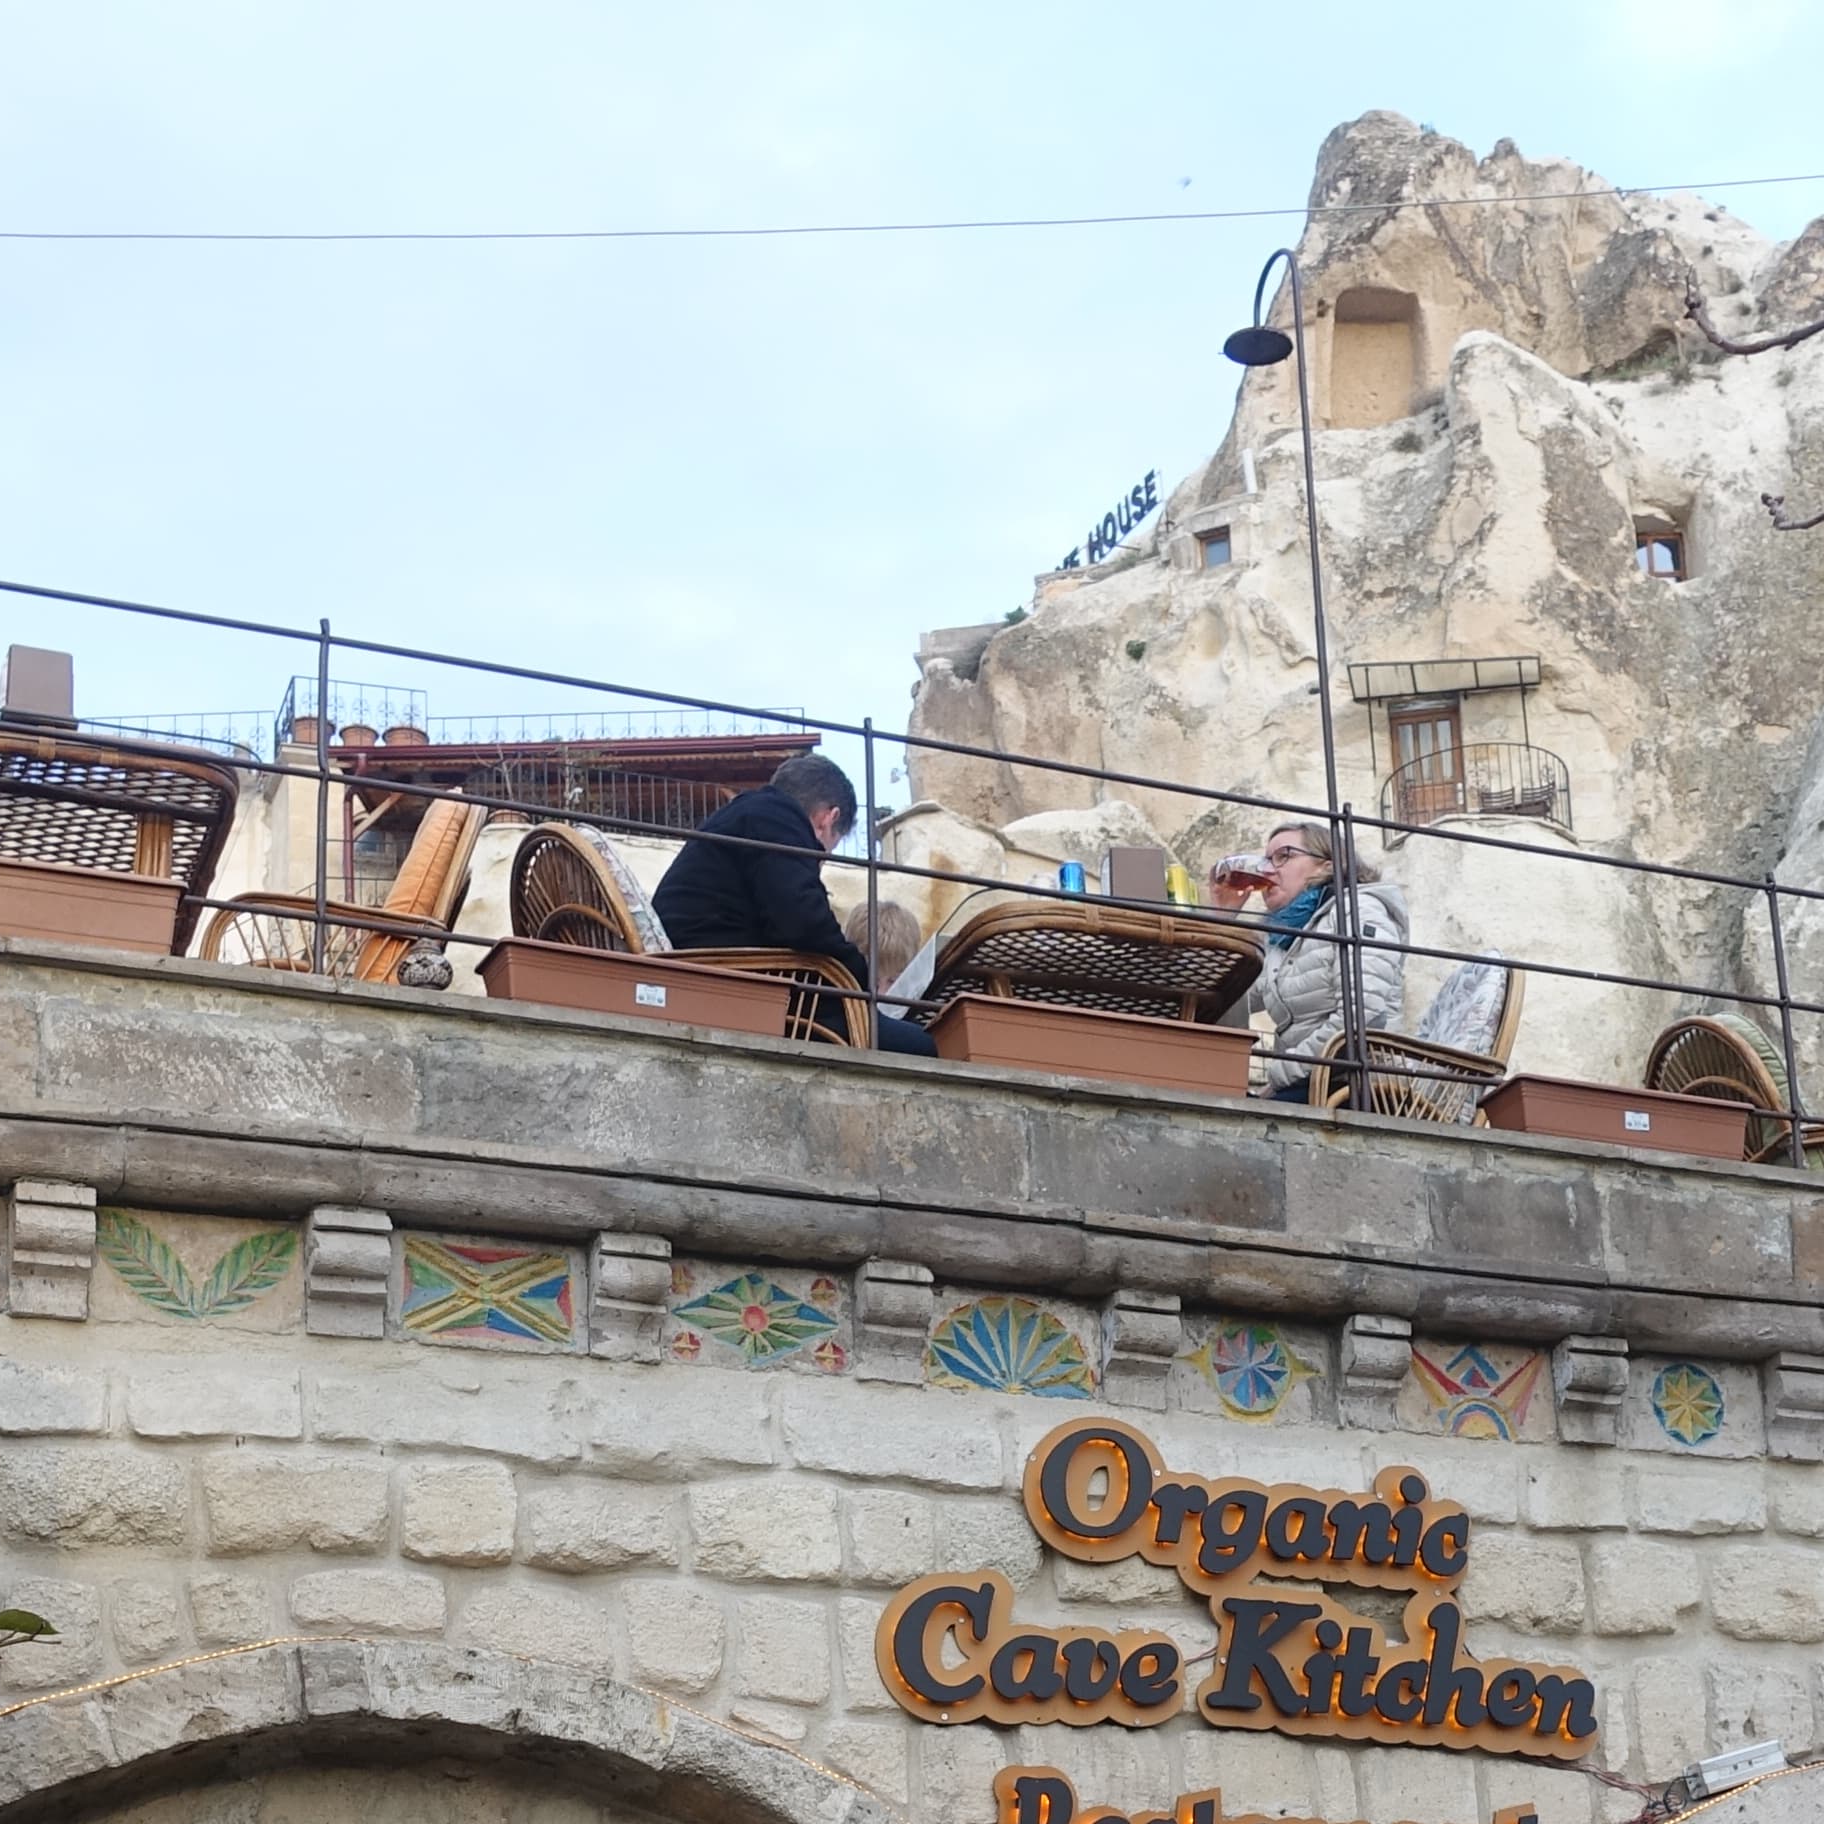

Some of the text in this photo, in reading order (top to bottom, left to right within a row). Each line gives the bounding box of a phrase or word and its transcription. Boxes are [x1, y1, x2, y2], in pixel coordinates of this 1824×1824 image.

[1088, 468, 1158, 564] HOUSE
[1040, 1428, 1468, 1577] Organic
[892, 1582, 1597, 1738] Cave Kitchen
